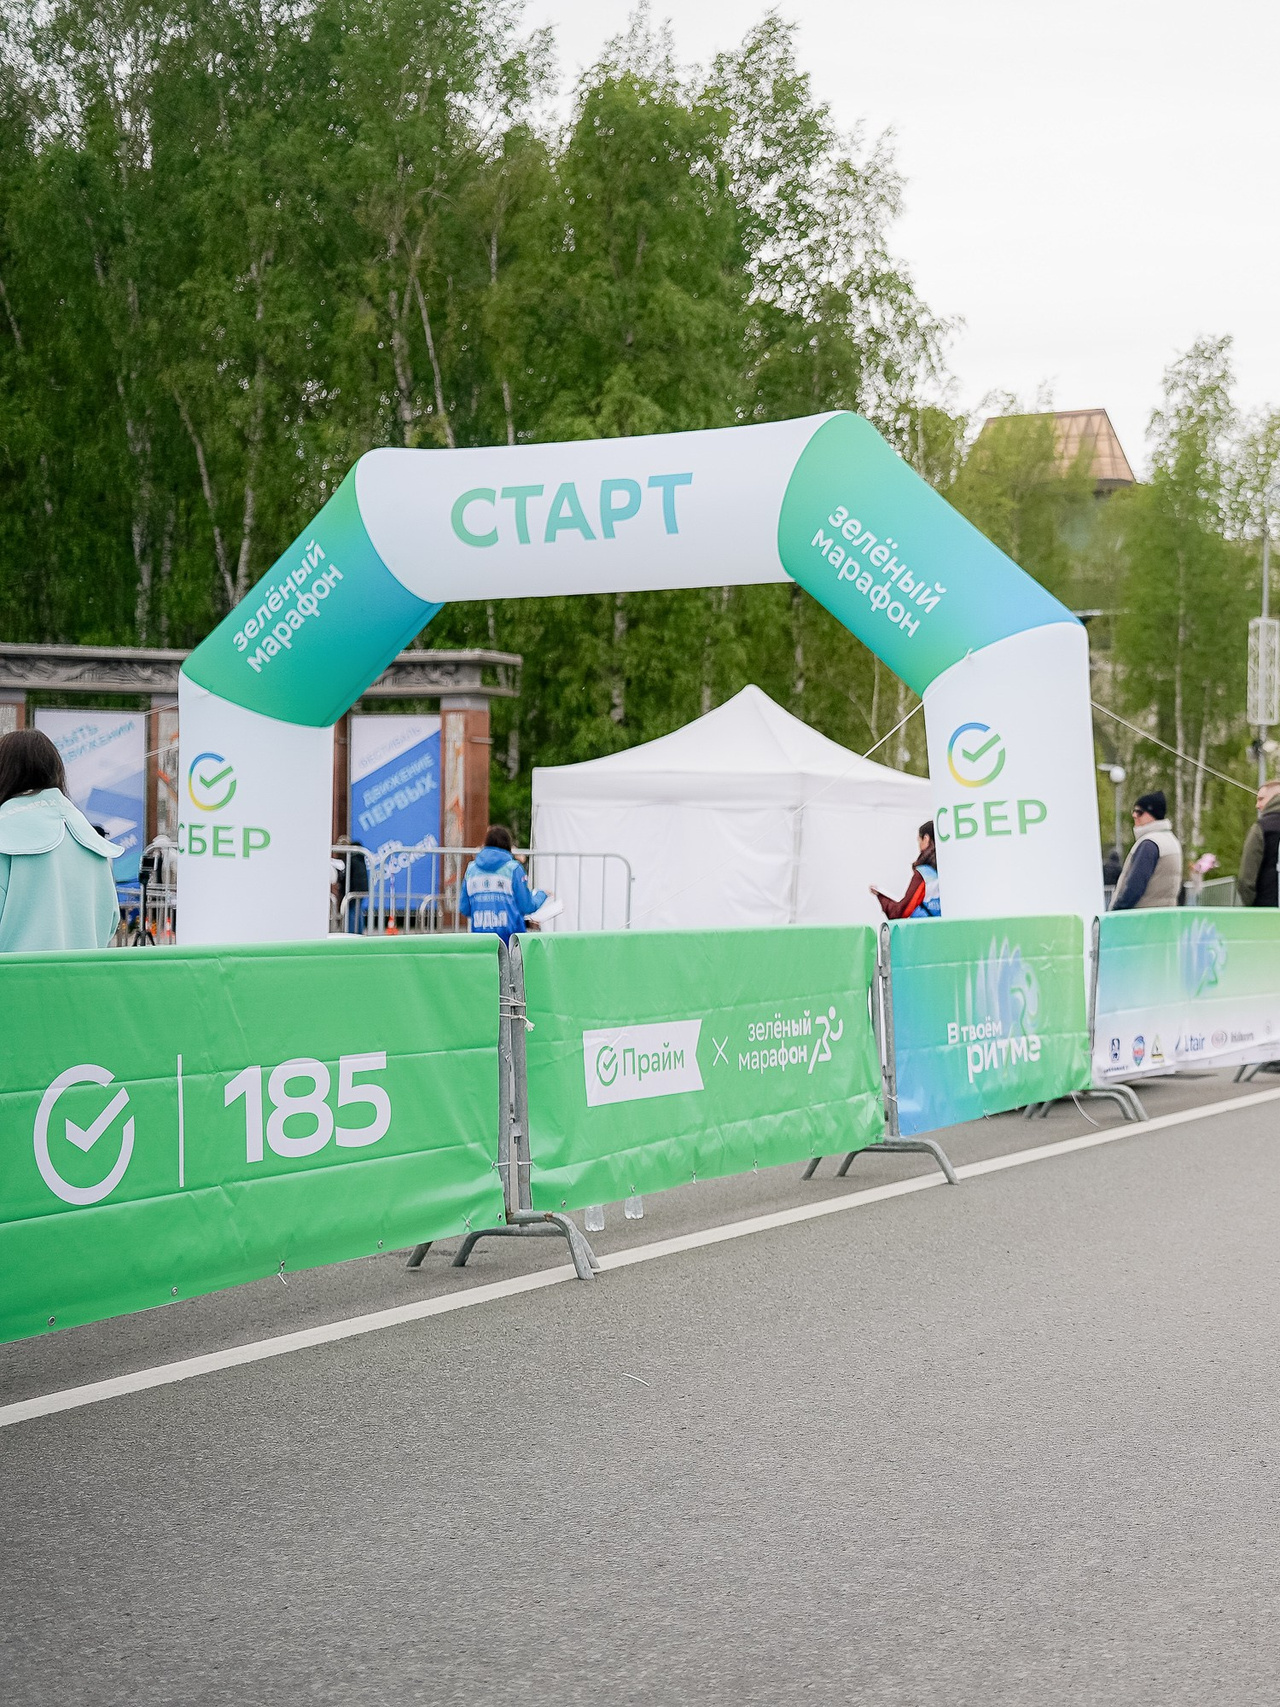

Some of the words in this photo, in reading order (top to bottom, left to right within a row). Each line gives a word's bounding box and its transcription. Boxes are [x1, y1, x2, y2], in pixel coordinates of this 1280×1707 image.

[450, 472, 693, 548] СТАРТ
[810, 528, 921, 639] марафон
[827, 504, 947, 615] зелёный
[232, 538, 326, 653] зелёный
[246, 563, 344, 674] марафон
[358, 771, 438, 832] ПЕРВЫХ
[936, 799, 1048, 842] СБЕР
[748, 1010, 812, 1042] зелёный
[947, 1022, 959, 1045] В
[960, 1015, 1002, 1042] твоём
[622, 1042, 685, 1081] Прайм
[738, 1040, 808, 1074] марафон
[966, 1034, 1041, 1084] ритме
[224, 1051, 392, 1164] 185
